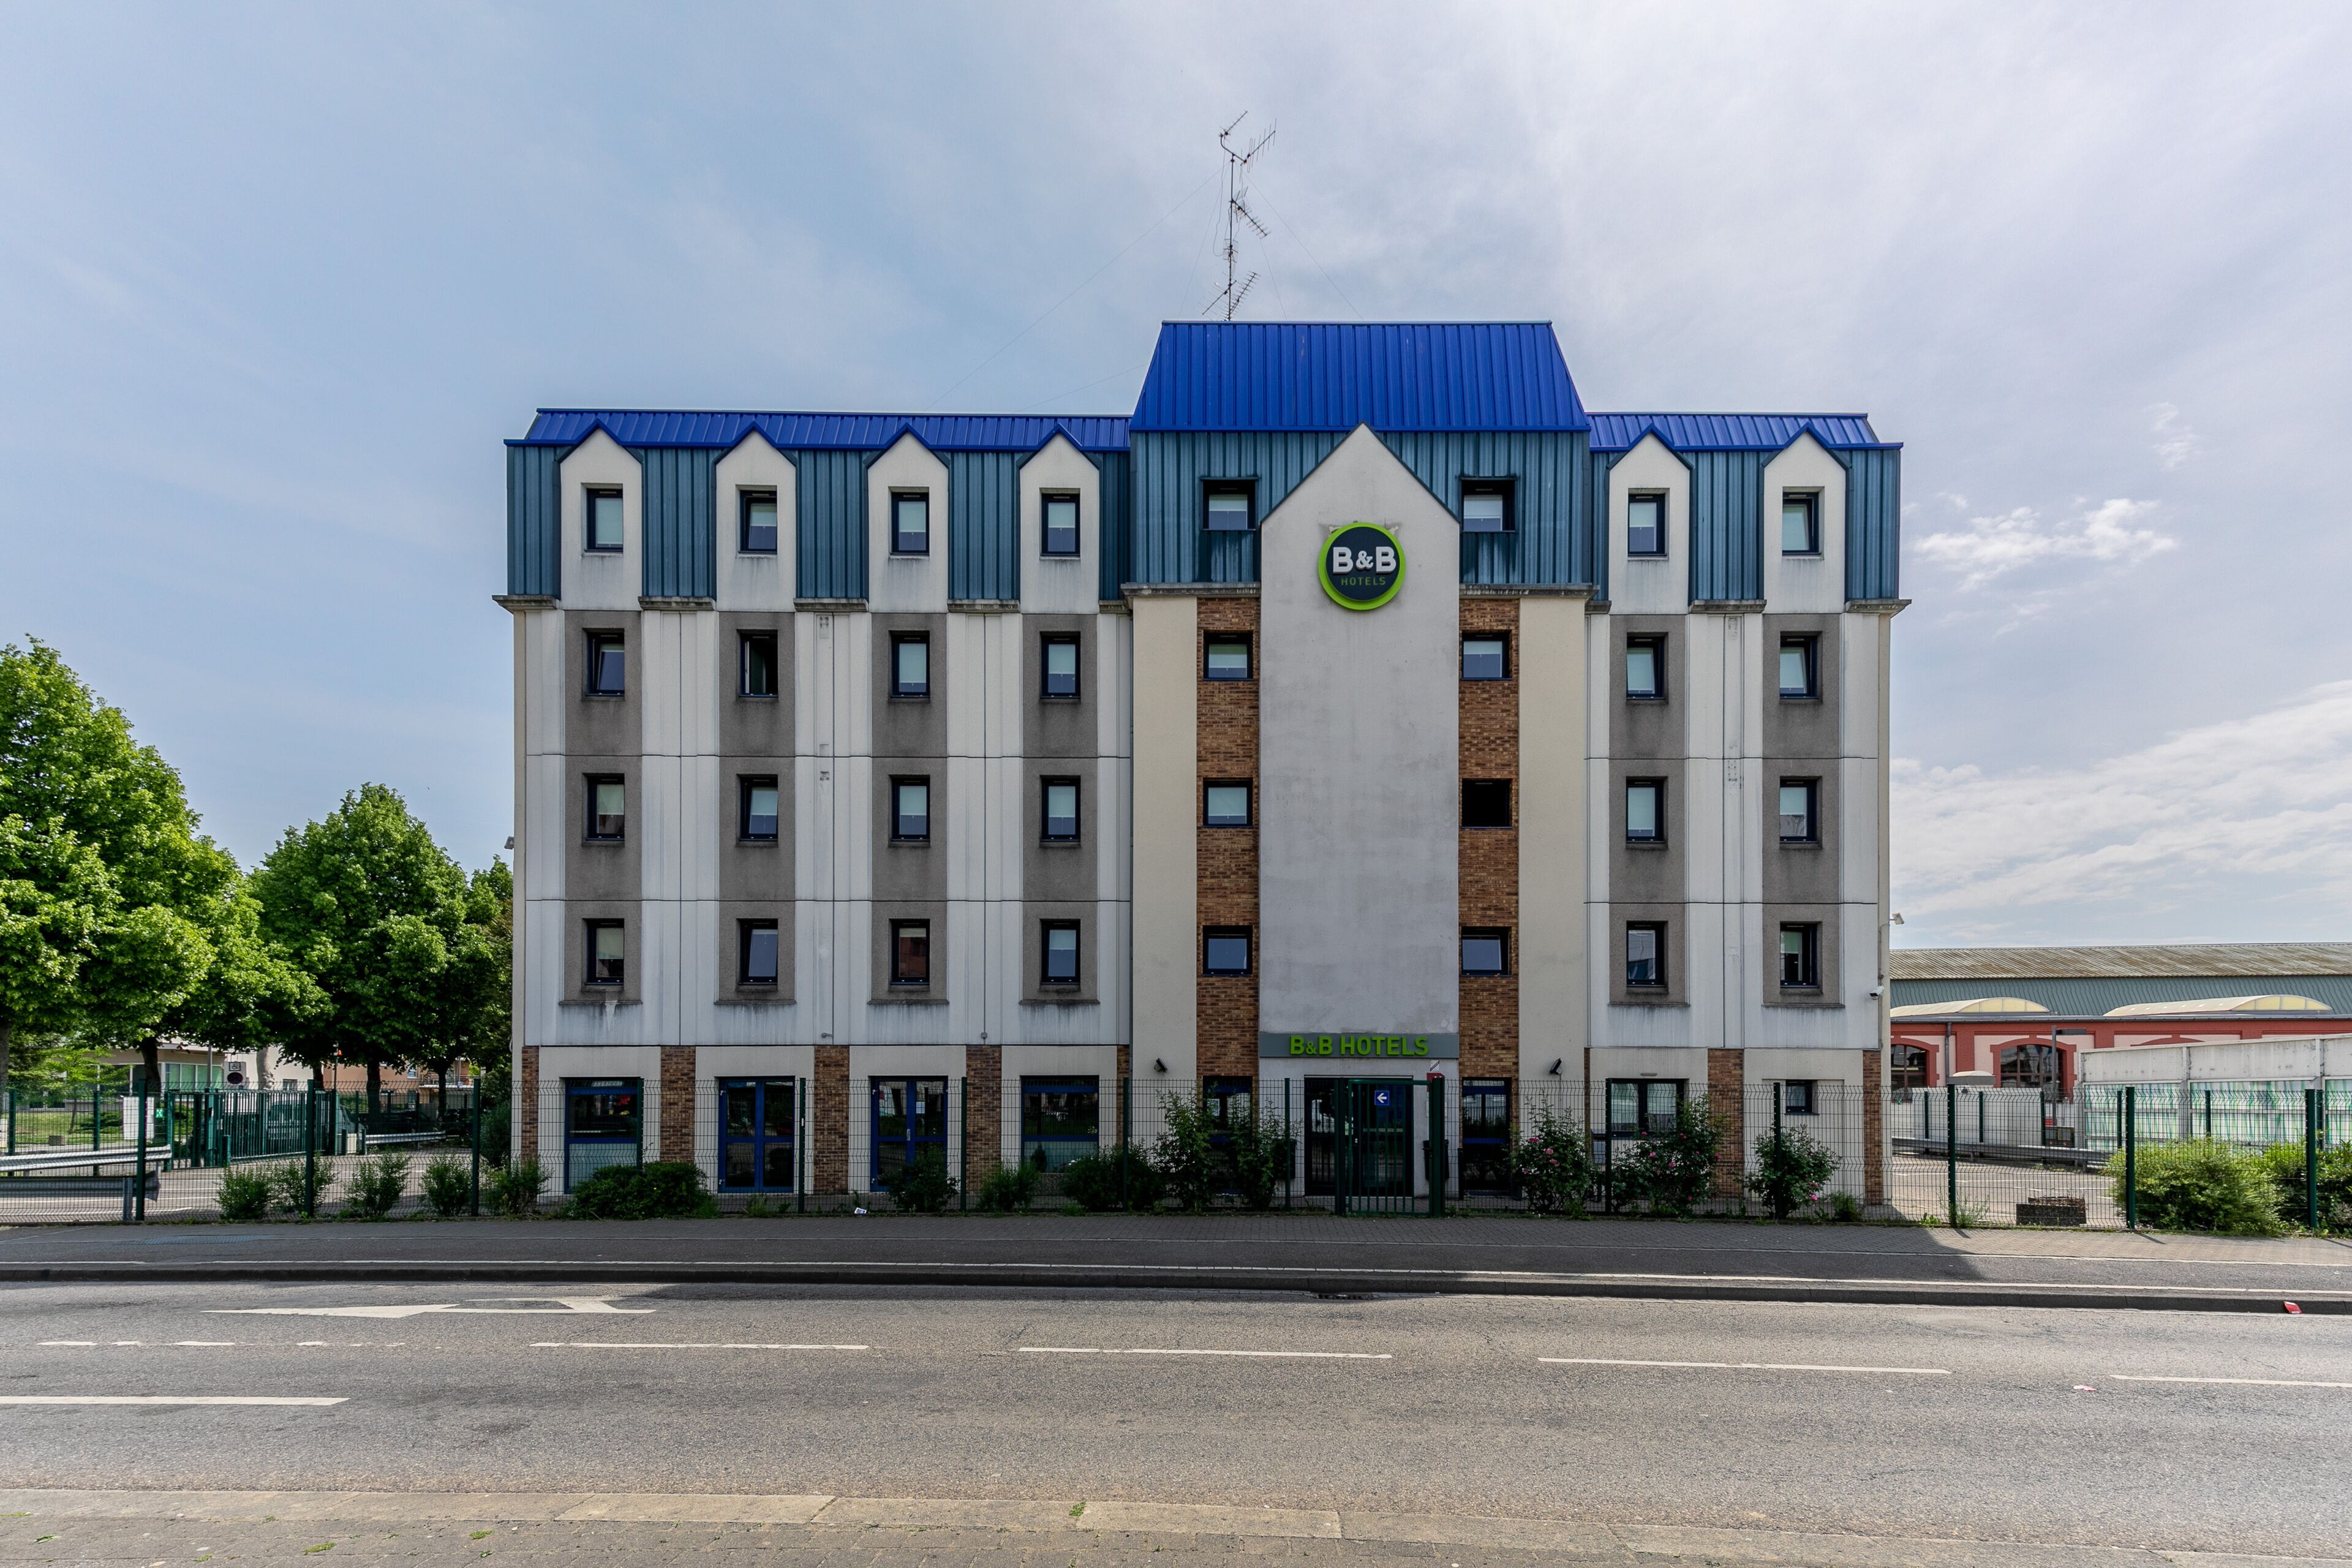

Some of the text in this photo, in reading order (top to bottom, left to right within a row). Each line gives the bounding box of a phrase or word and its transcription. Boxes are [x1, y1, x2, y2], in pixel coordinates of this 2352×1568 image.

[1333, 546, 1396, 574] B&B
[1341, 577, 1386, 586] HOTELS
[1289, 1036, 1429, 1056] B&B HOTELS
